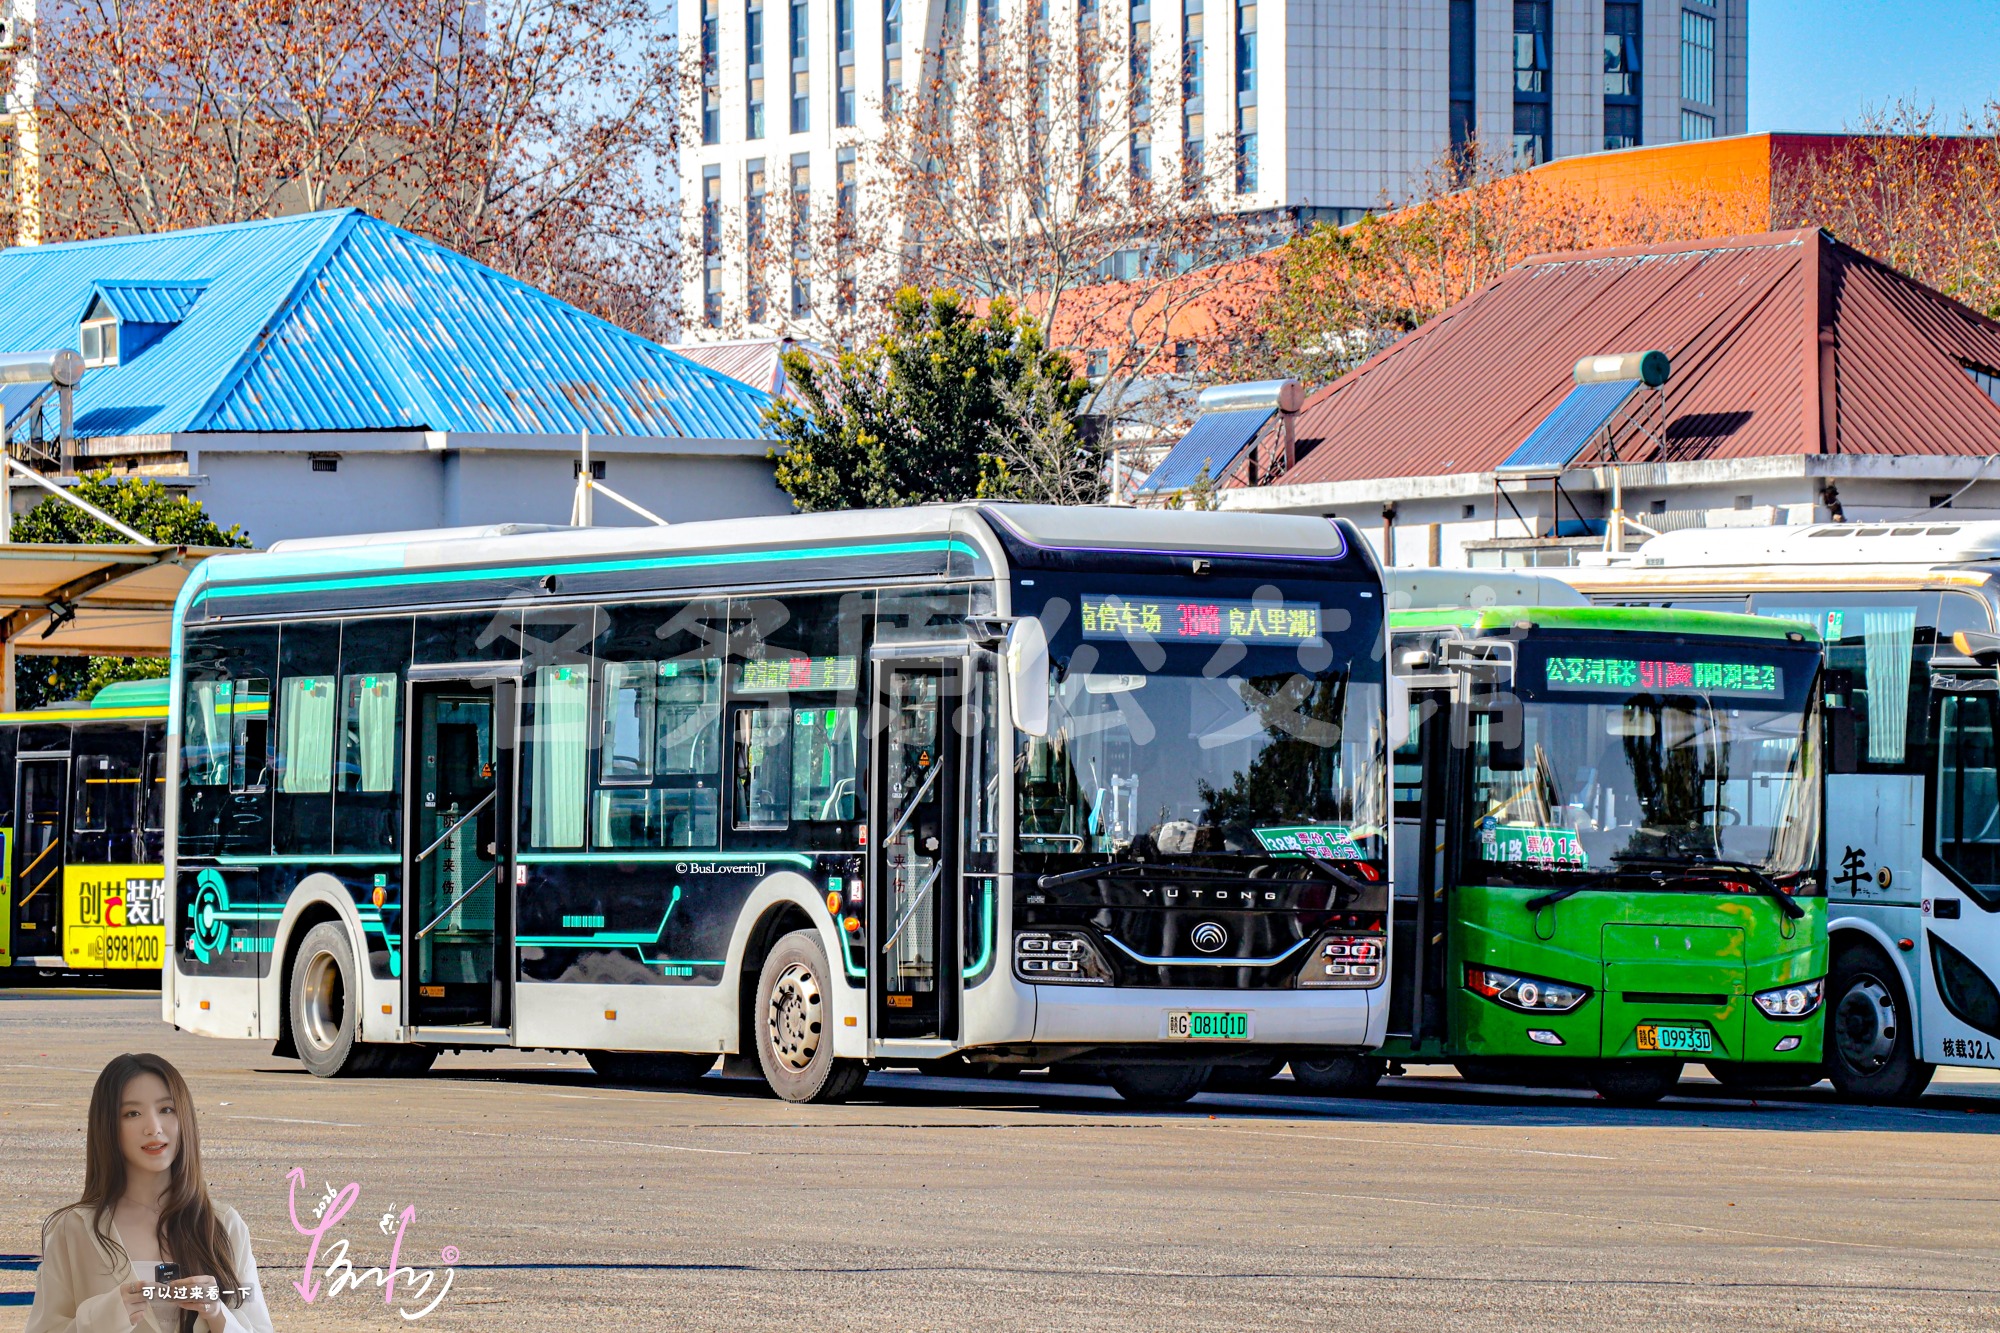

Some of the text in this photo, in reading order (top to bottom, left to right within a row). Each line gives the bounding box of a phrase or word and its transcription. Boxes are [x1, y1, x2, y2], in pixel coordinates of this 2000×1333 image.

[1833, 845, 1873, 898] 年
[1142, 889, 1276, 900] YUTONG
[106, 935, 158, 962] 8981200
[1943, 1037, 1995, 1060] 核载32人
